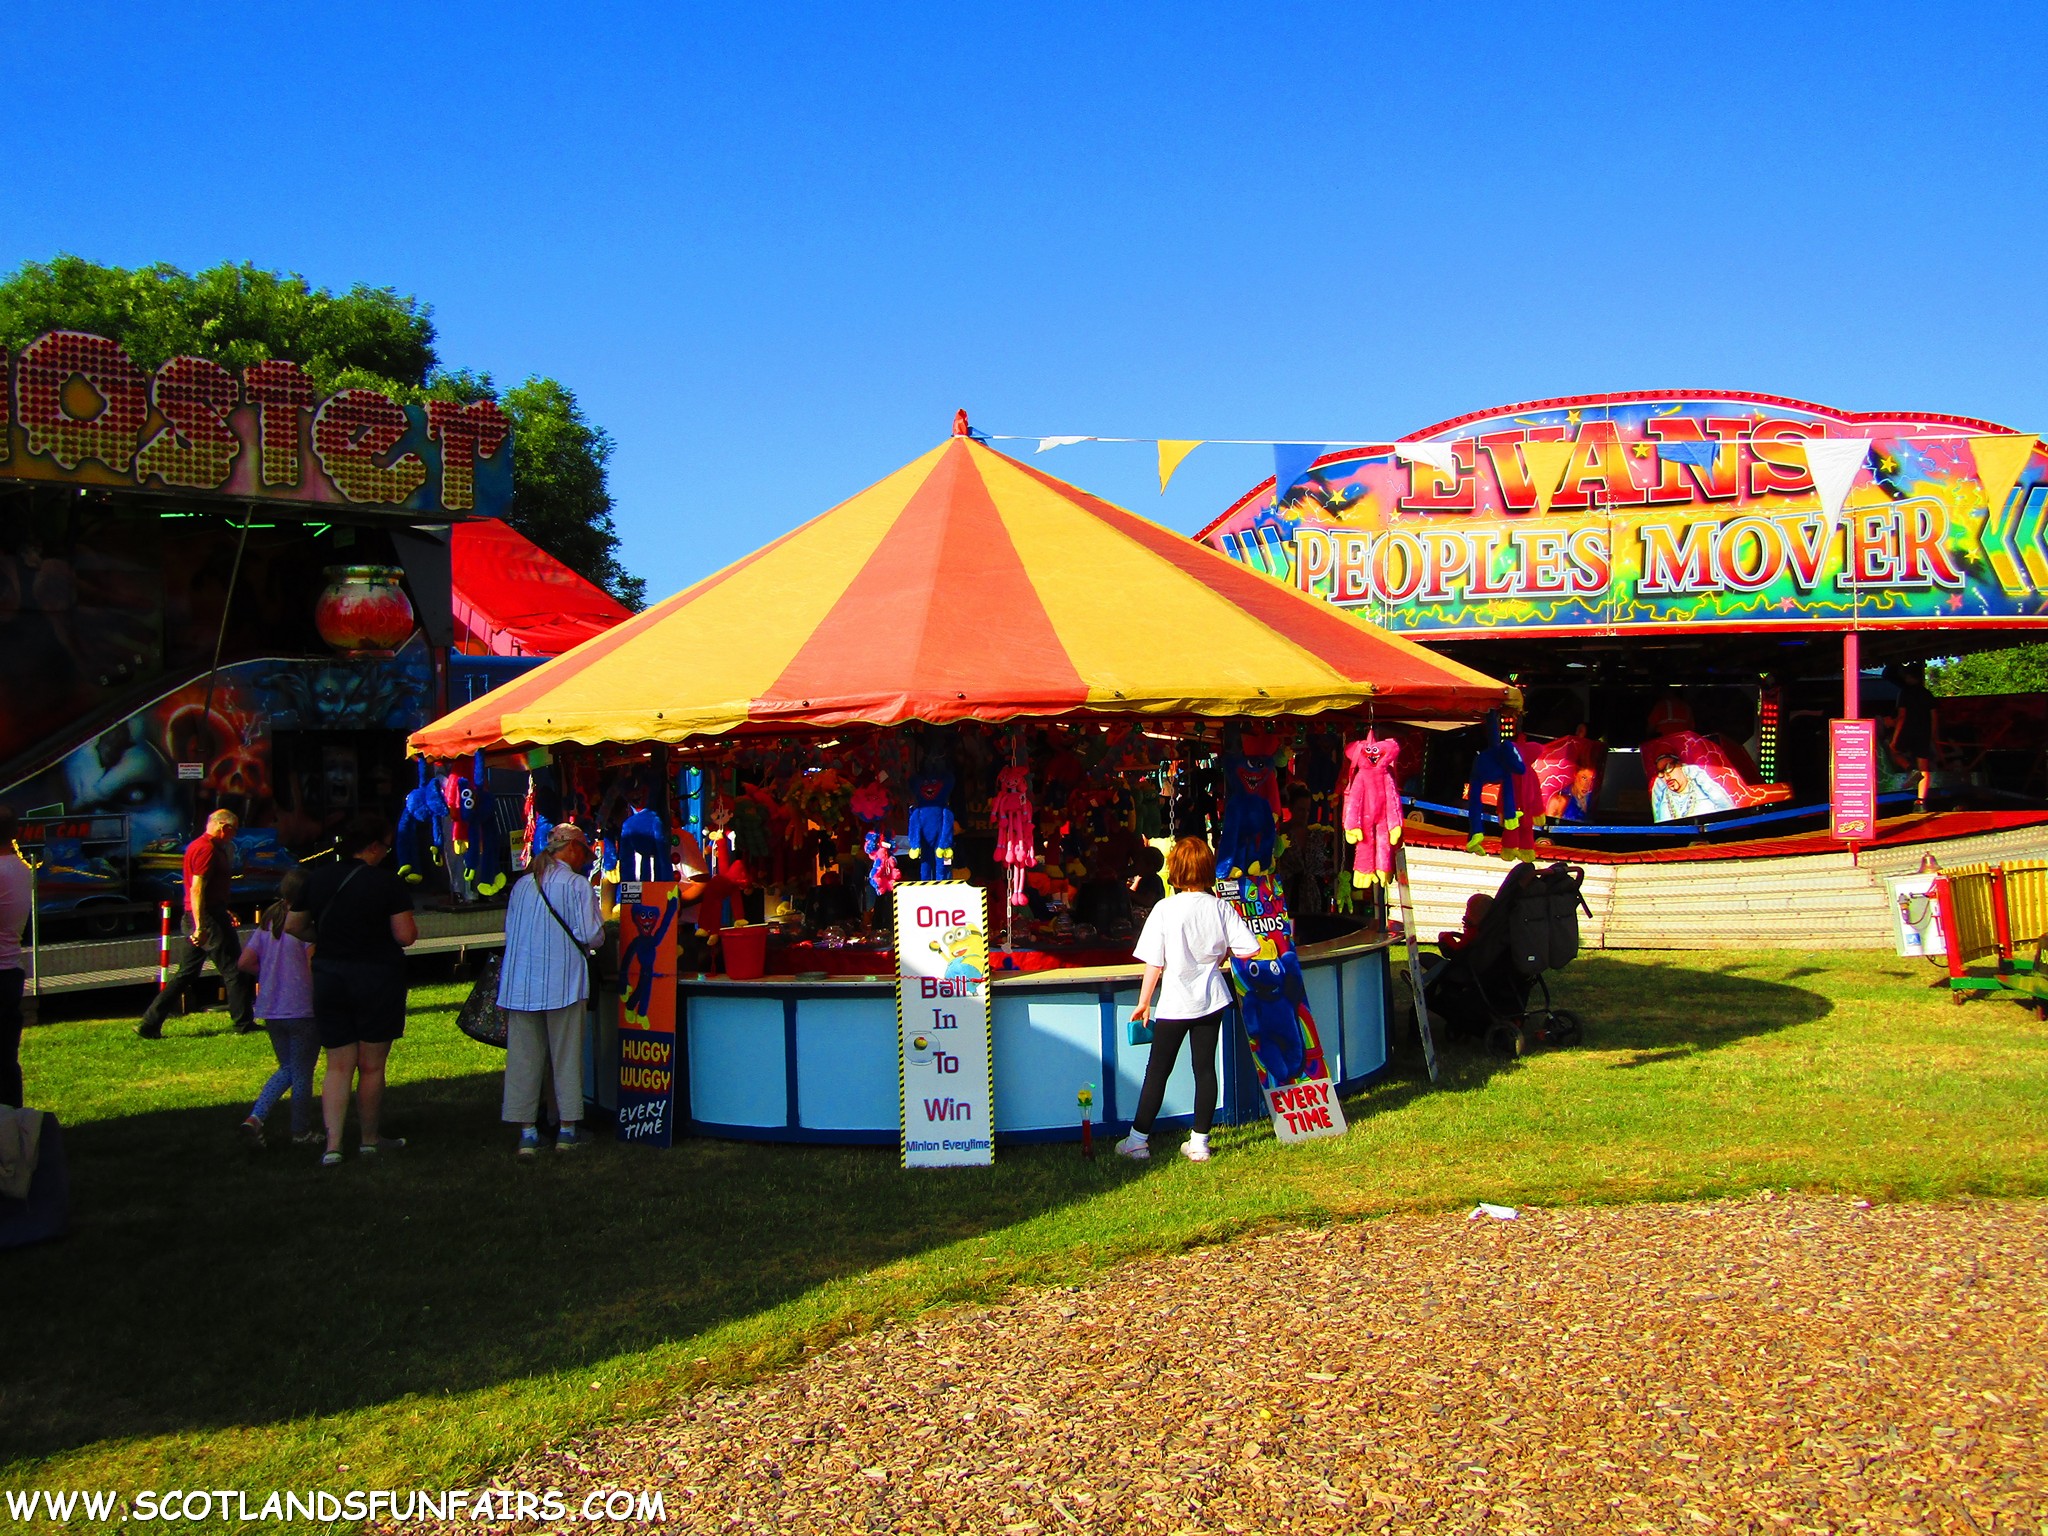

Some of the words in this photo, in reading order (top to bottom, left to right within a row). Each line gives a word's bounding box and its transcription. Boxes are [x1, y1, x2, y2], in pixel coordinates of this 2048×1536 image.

[1401, 417, 1828, 511] EVANS
[1293, 528, 1615, 605] PEOPLES
[1637, 496, 1966, 594] MOVER
[916, 905, 967, 928] One
[1245, 916, 1284, 934] IENDS
[920, 975, 967, 999] Ball
[932, 1008, 958, 1030] In
[622, 1039, 671, 1063] HUGGY
[932, 1051, 959, 1074] To
[620, 1066, 671, 1091] WUGGY
[923, 1097, 971, 1122] Win
[1270, 1082, 1329, 1113] EVERY
[619, 1099, 667, 1123] EVERY
[1283, 1106, 1334, 1135] TIME
[624, 1119, 663, 1139] TIME
[906, 1140, 940, 1152] Minion
[942, 1138, 990, 1151] Everytime
